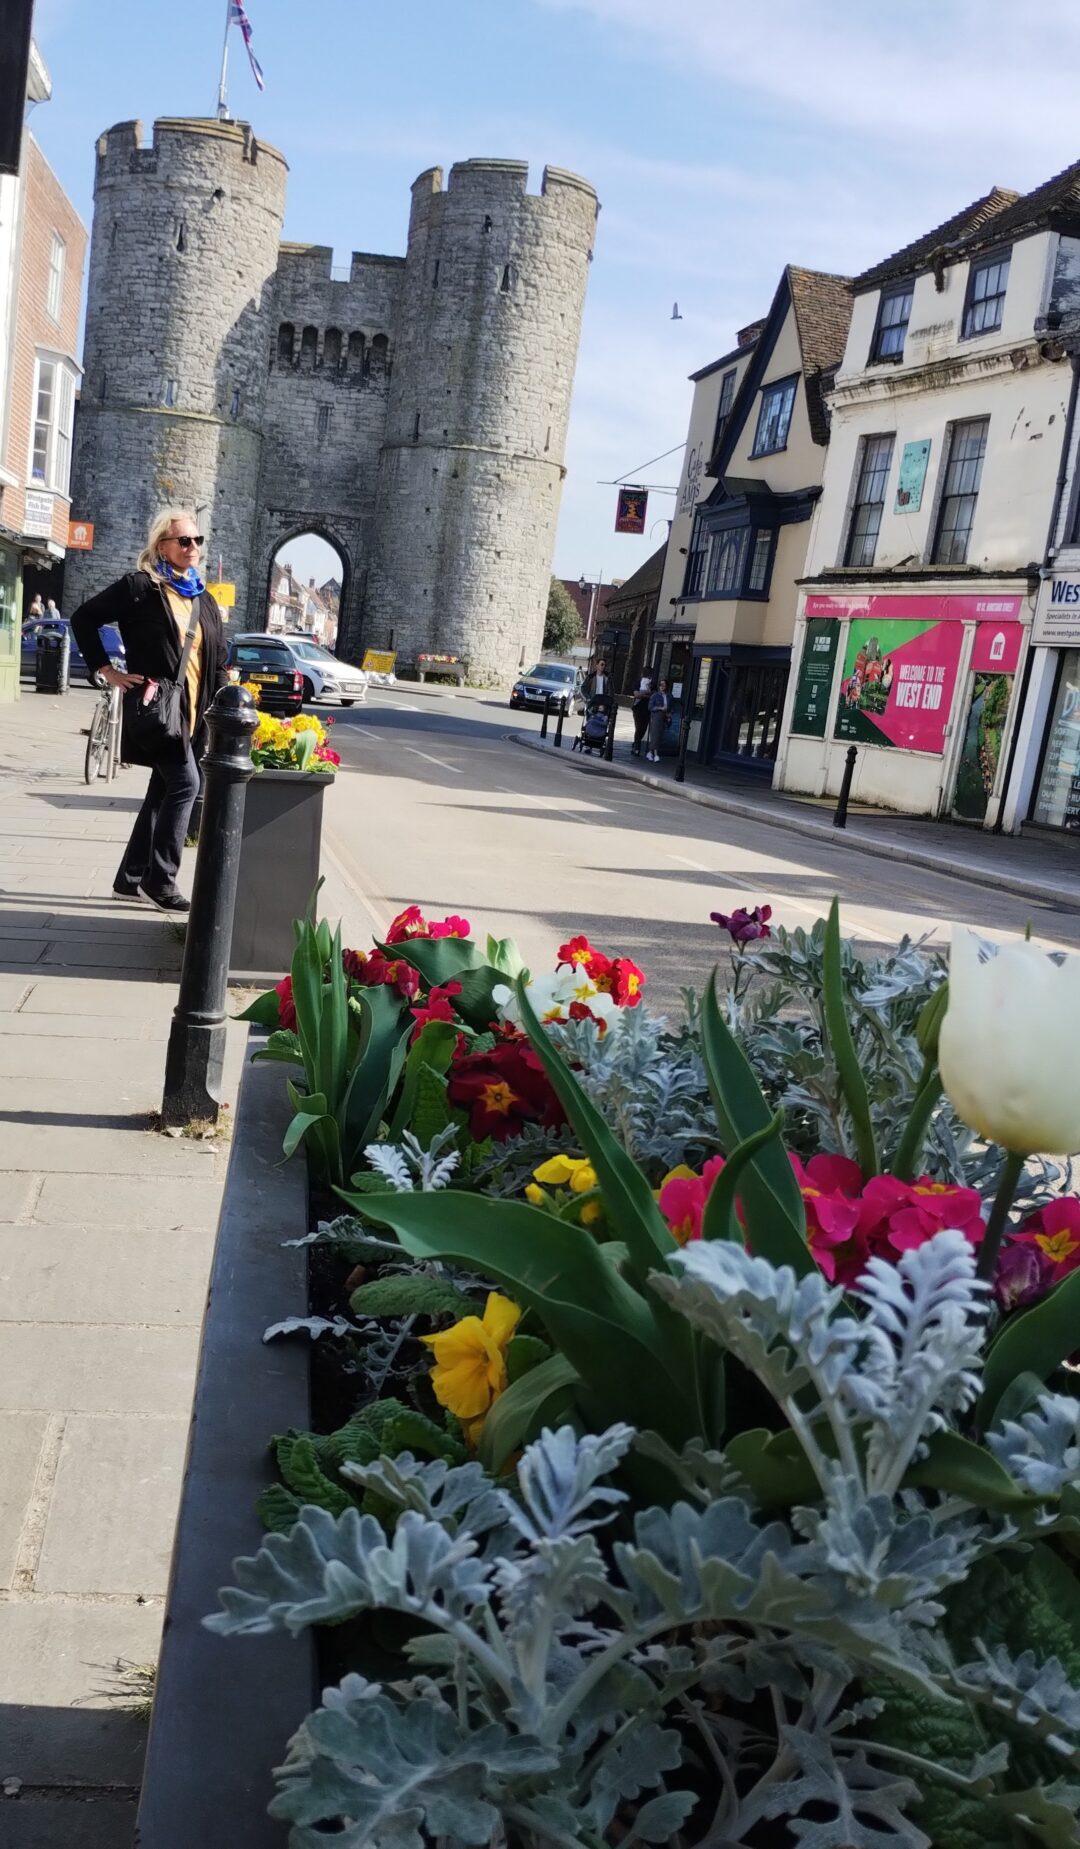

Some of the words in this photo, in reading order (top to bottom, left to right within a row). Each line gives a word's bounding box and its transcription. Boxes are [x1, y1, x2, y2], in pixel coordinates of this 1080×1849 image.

[899, 664, 926, 681] WELCOME
[927, 665, 935, 682] TO
[935, 666, 946, 683] THE
[896, 681, 923, 708] WEST
[921, 683, 943, 710] END
